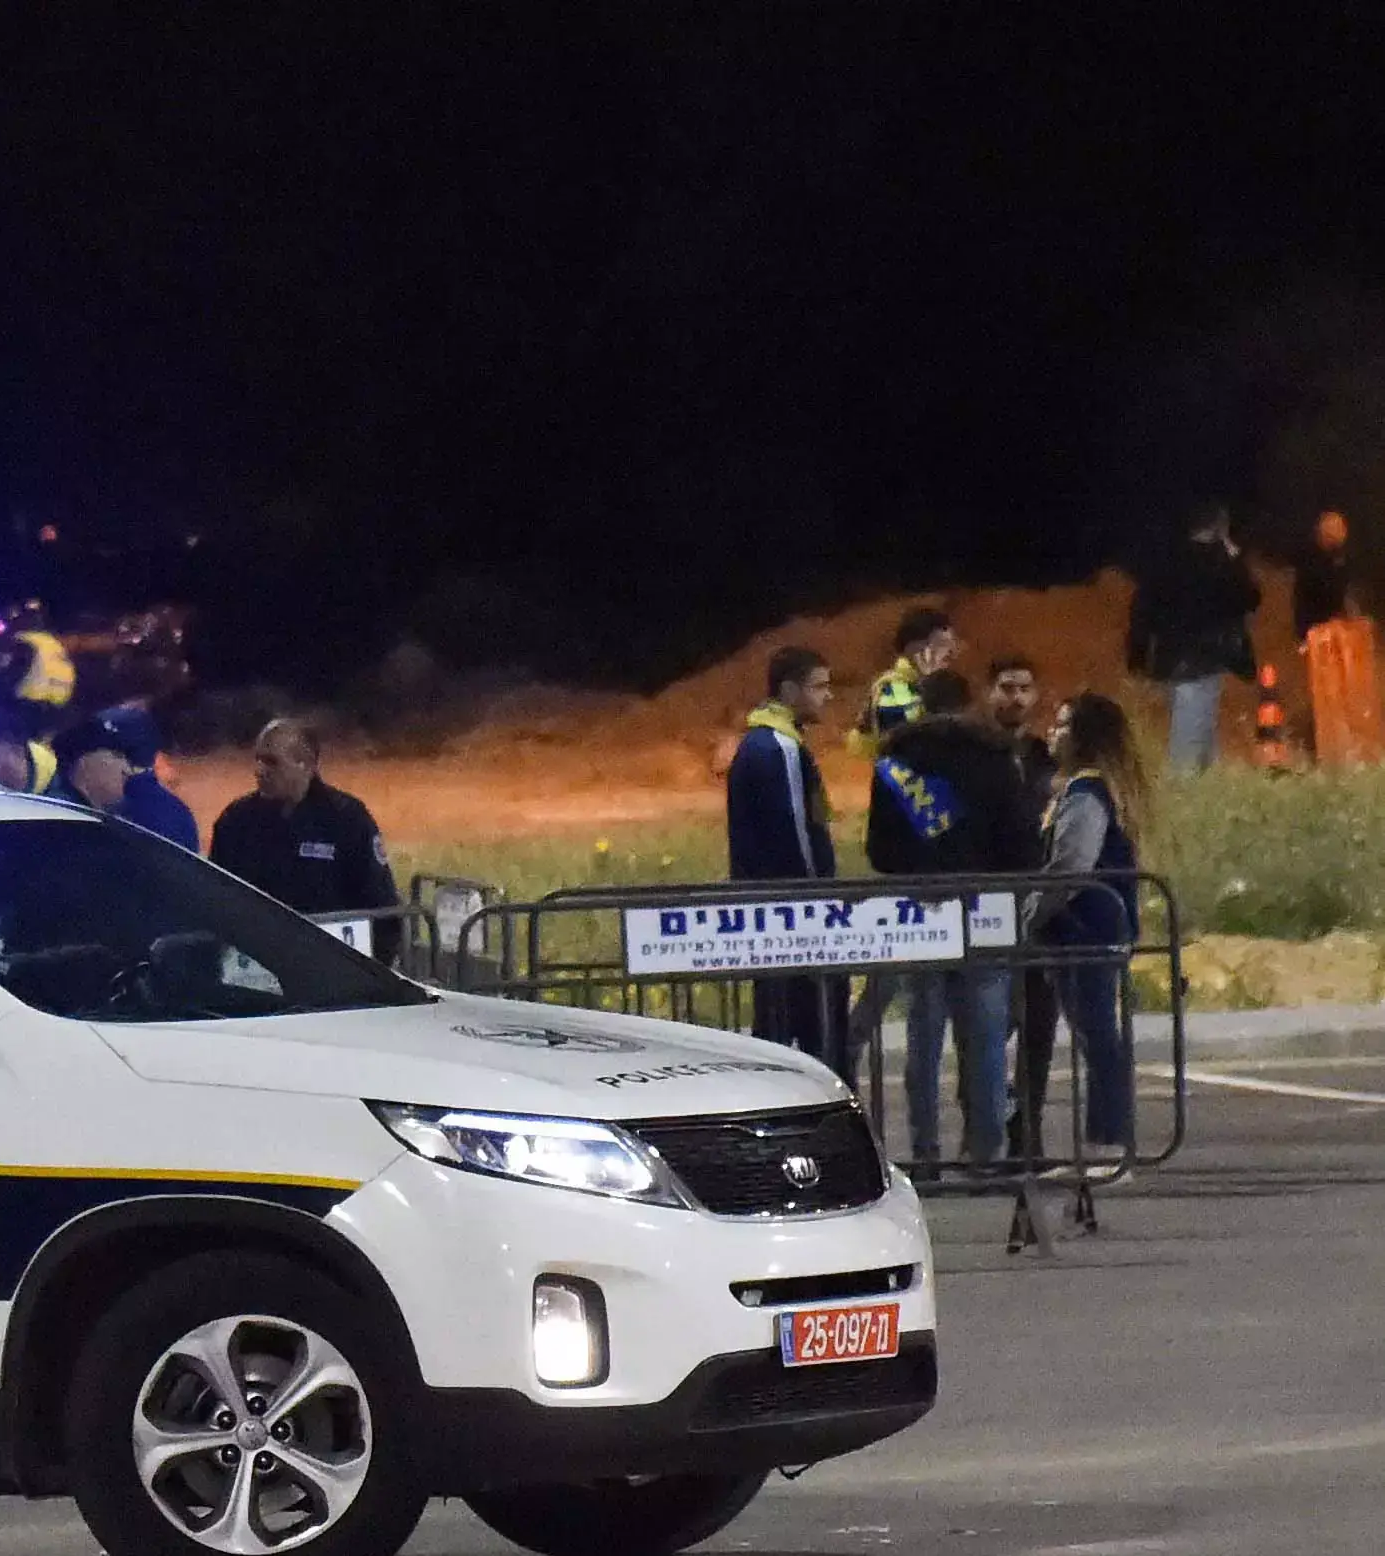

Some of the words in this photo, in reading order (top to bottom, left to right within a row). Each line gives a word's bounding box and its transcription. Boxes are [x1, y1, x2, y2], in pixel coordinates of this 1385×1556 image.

[660, 902, 853, 936] אירועים
[641, 938, 715, 956] לאירועים
[692, 946, 893, 968] www.bamot4u.co.il
